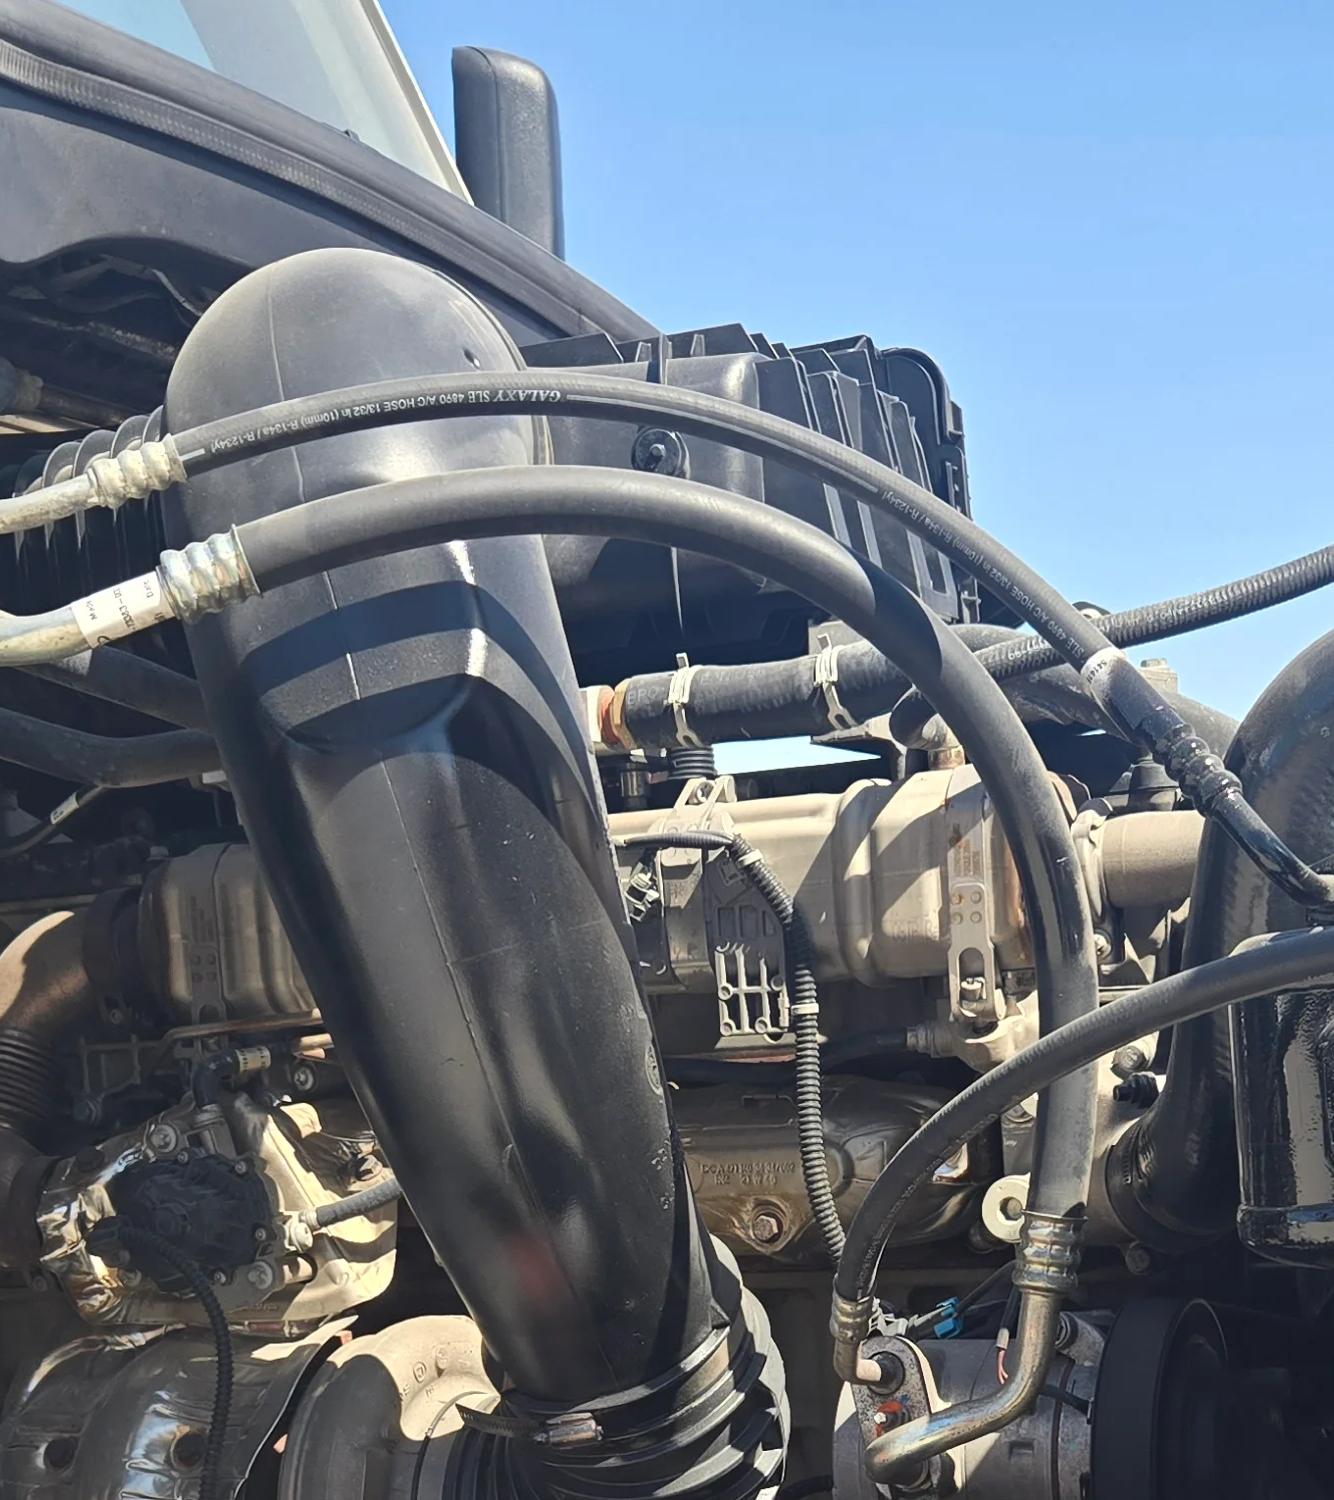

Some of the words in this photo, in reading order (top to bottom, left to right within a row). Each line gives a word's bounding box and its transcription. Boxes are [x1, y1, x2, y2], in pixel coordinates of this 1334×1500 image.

[417, 394, 436, 408] A/C
[440, 392, 465, 405] 4890
[468, 389, 491, 403] SLE
[495, 389, 561, 403] GALAXY
[354, 401, 382, 416] 13/32
[384, 397, 416, 412] HOSE
[301, 408, 339, 429] (10mm)
[263, 418, 300, 437] R-134a
[1010, 586, 1036, 611] HOSE
[1033, 605, 1049, 623] A/C
[1047, 620, 1067, 640] 4890
[1066, 636, 1085, 659] SLE
